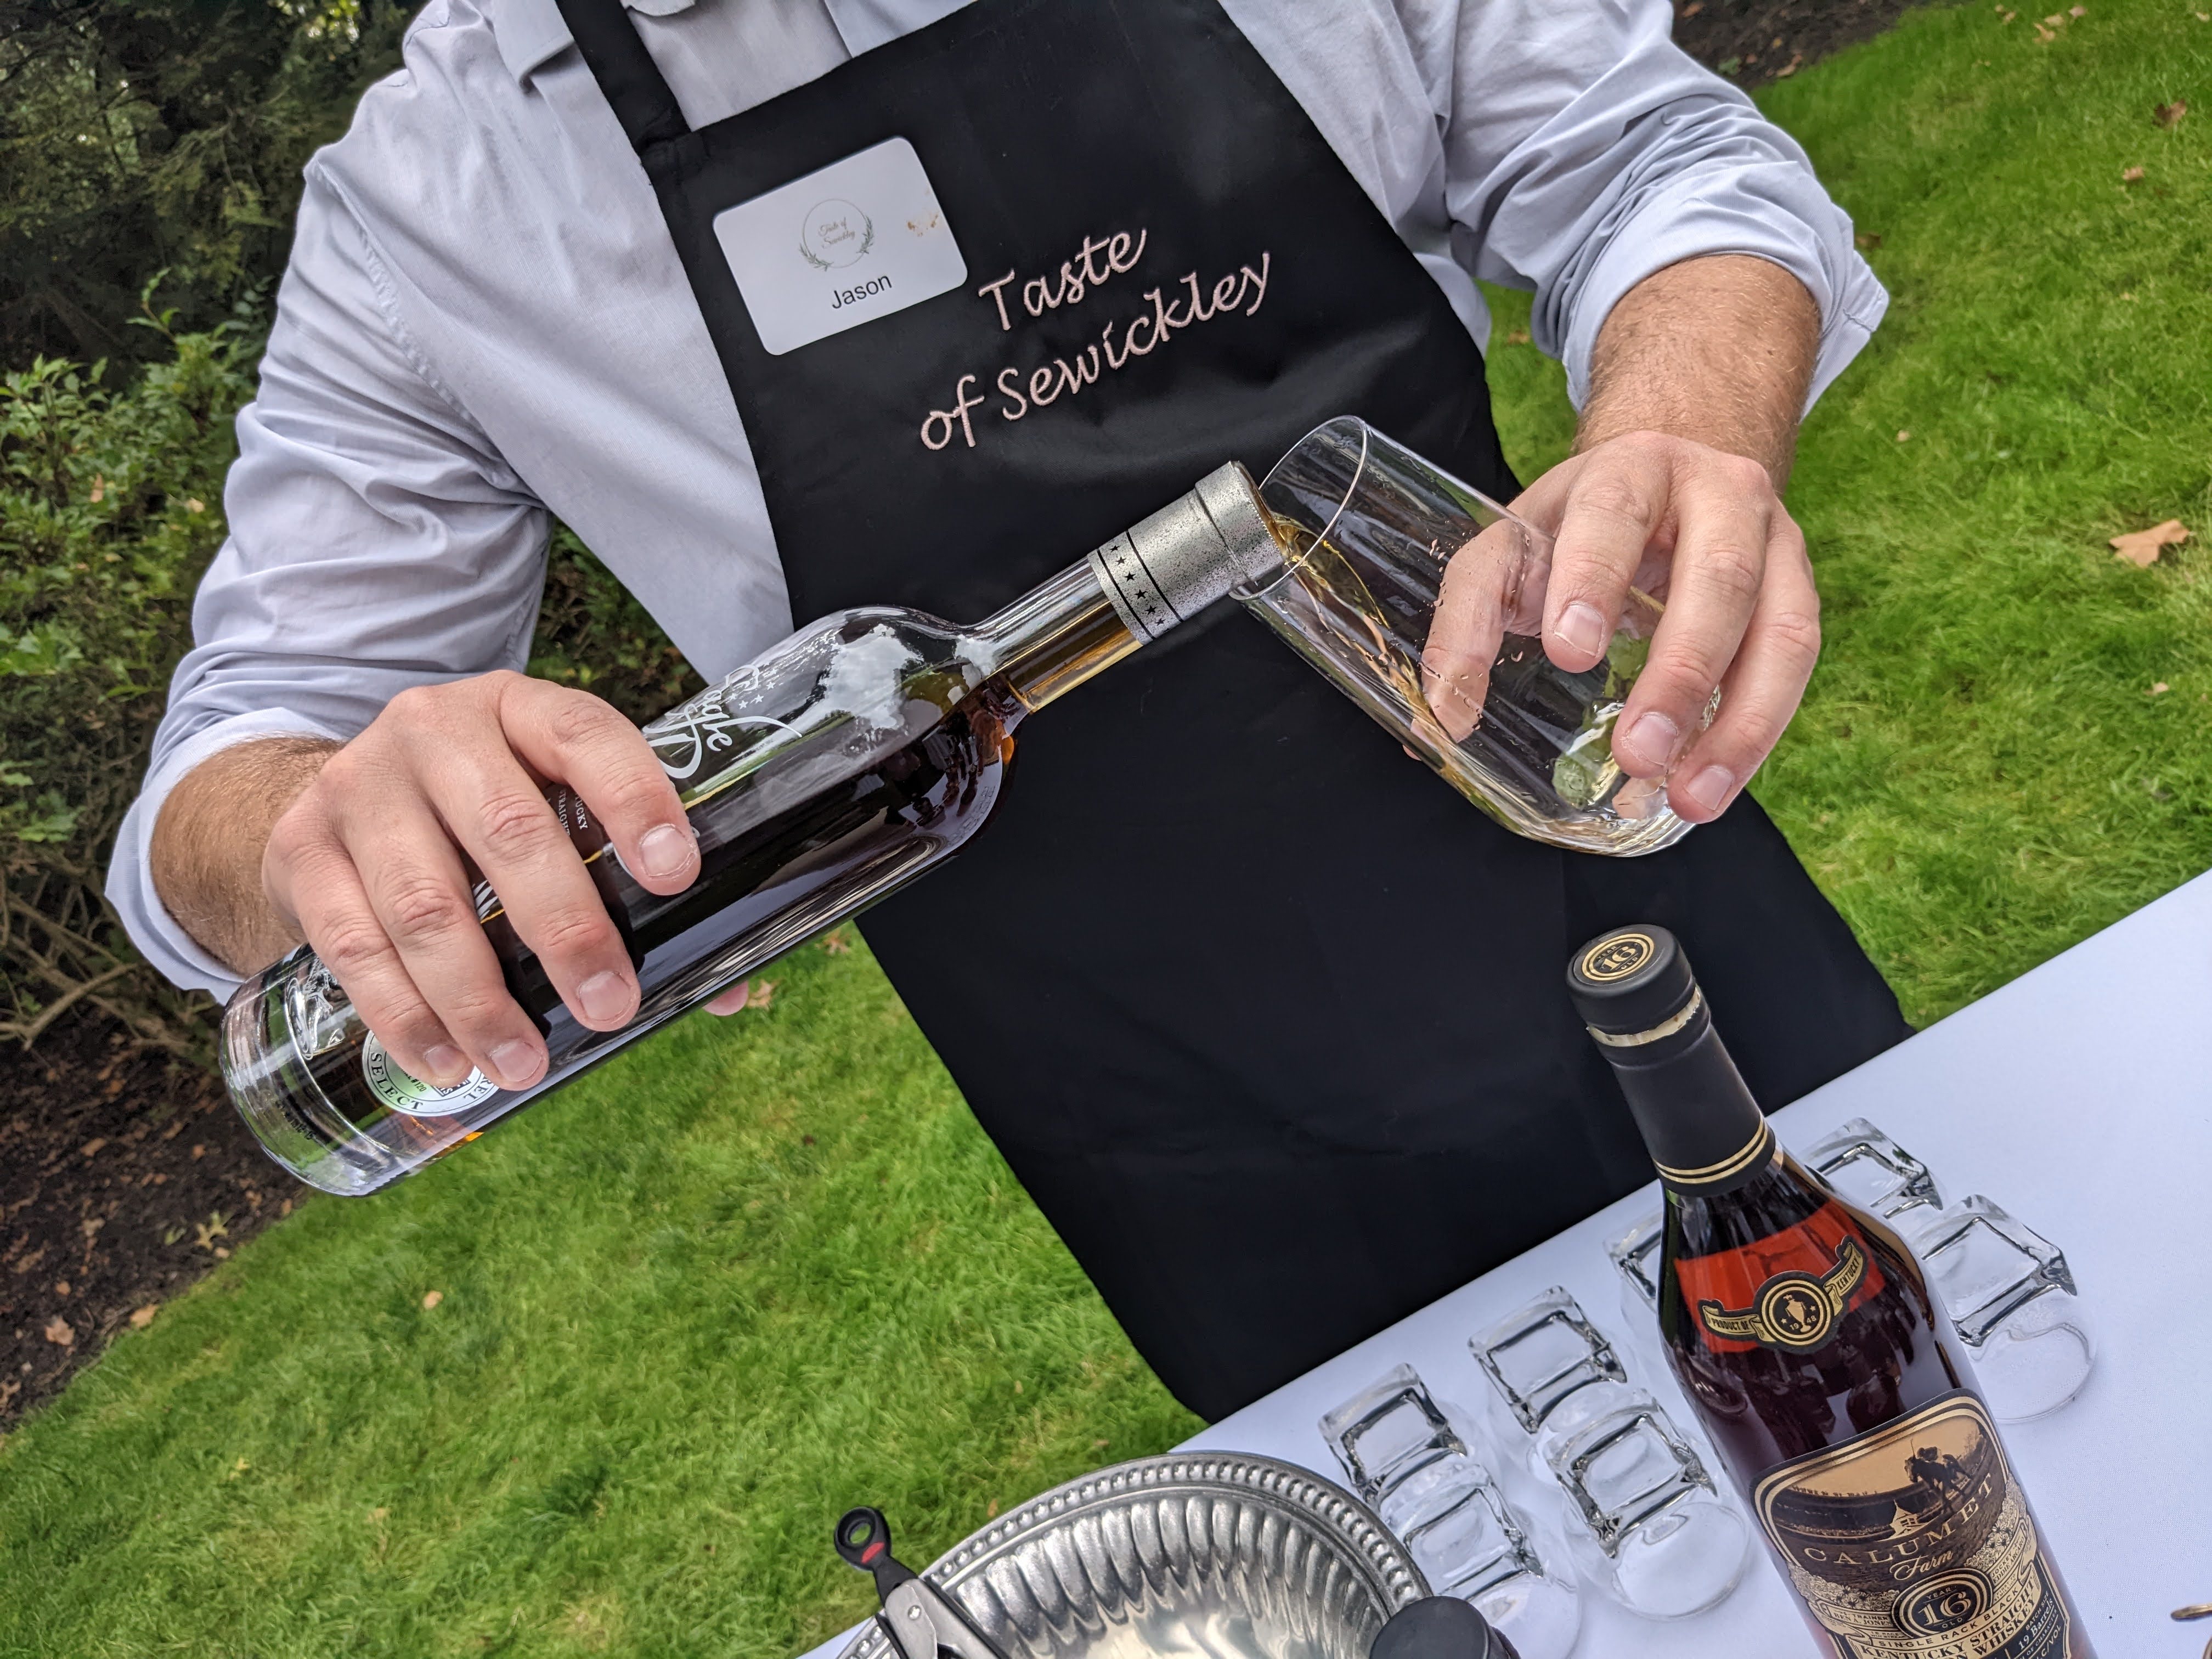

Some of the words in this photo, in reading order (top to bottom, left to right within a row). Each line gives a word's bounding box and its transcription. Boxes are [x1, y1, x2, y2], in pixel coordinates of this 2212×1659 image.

[832, 275, 892, 309] Jason
[978, 228, 1147, 331] Taste
[921, 375, 984, 450] of
[997, 251, 1271, 421] Sewickley
[1597, 946, 1617, 960] YEAR
[1599, 946, 1637, 971] 16
[1621, 957, 1638, 969] OLD
[370, 1052, 424, 1110] SELECT
[1836, 1255, 1860, 1290] KENTUCKY
[1711, 1317, 1740, 1330] PRODUCT
[1740, 1321, 1749, 1330] OF
[1807, 1315, 1817, 1323] 48
[1804, 1472, 1993, 1565] CALUMET
[1889, 1550, 1954, 1581] Farm
[1992, 1551, 2012, 1578] JOCKEY
[1918, 1591, 1971, 1626] 16
[1926, 1587, 1951, 1600] YEAR
[1878, 1638, 1933, 1648] SINGLE
[1941, 1621, 1978, 1641] RACK
[1984, 1587, 2018, 1621] BLACK
[1942, 1617, 1962, 1628] OLD
[1970, 1576, 2034, 1647] STRAIGHT
[1973, 1592, 2035, 1656] WHISKEY
[2018, 1635, 2030, 1650] 19
[2030, 1598, 2053, 1638] Barrels
[2025, 1606, 2042, 1631] BATCH
